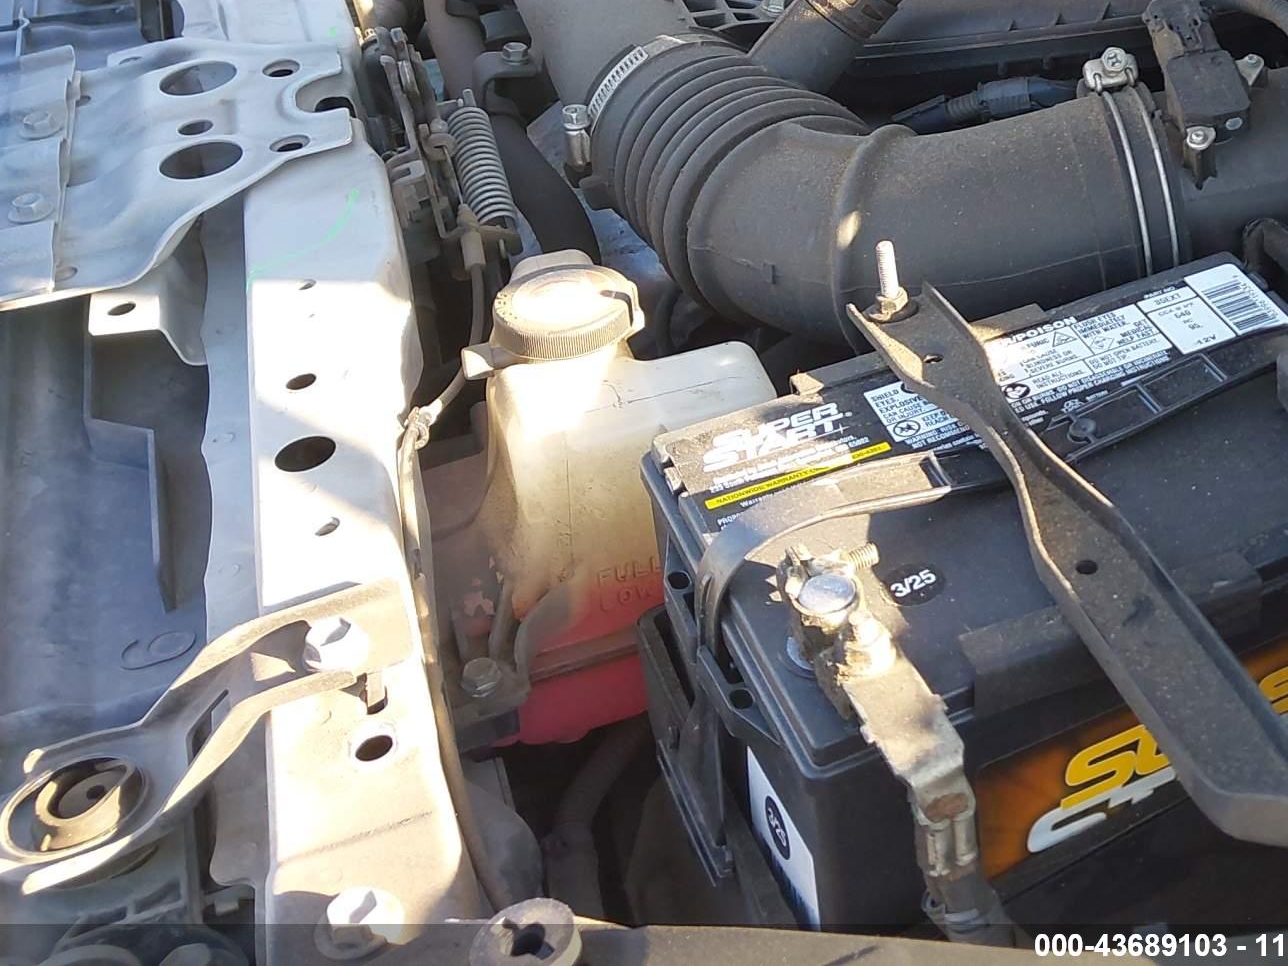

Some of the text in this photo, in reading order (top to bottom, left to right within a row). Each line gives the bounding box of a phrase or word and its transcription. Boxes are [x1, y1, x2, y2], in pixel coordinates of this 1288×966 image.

[869, 388, 900, 402] SHIELD
[716, 484, 764, 504] NATIONWIDE
[764, 469, 810, 488] WARRANTY
[597, 556, 661, 586] FULL
[890, 569, 937, 599] 3/25
[599, 585, 657, 611] LOW
